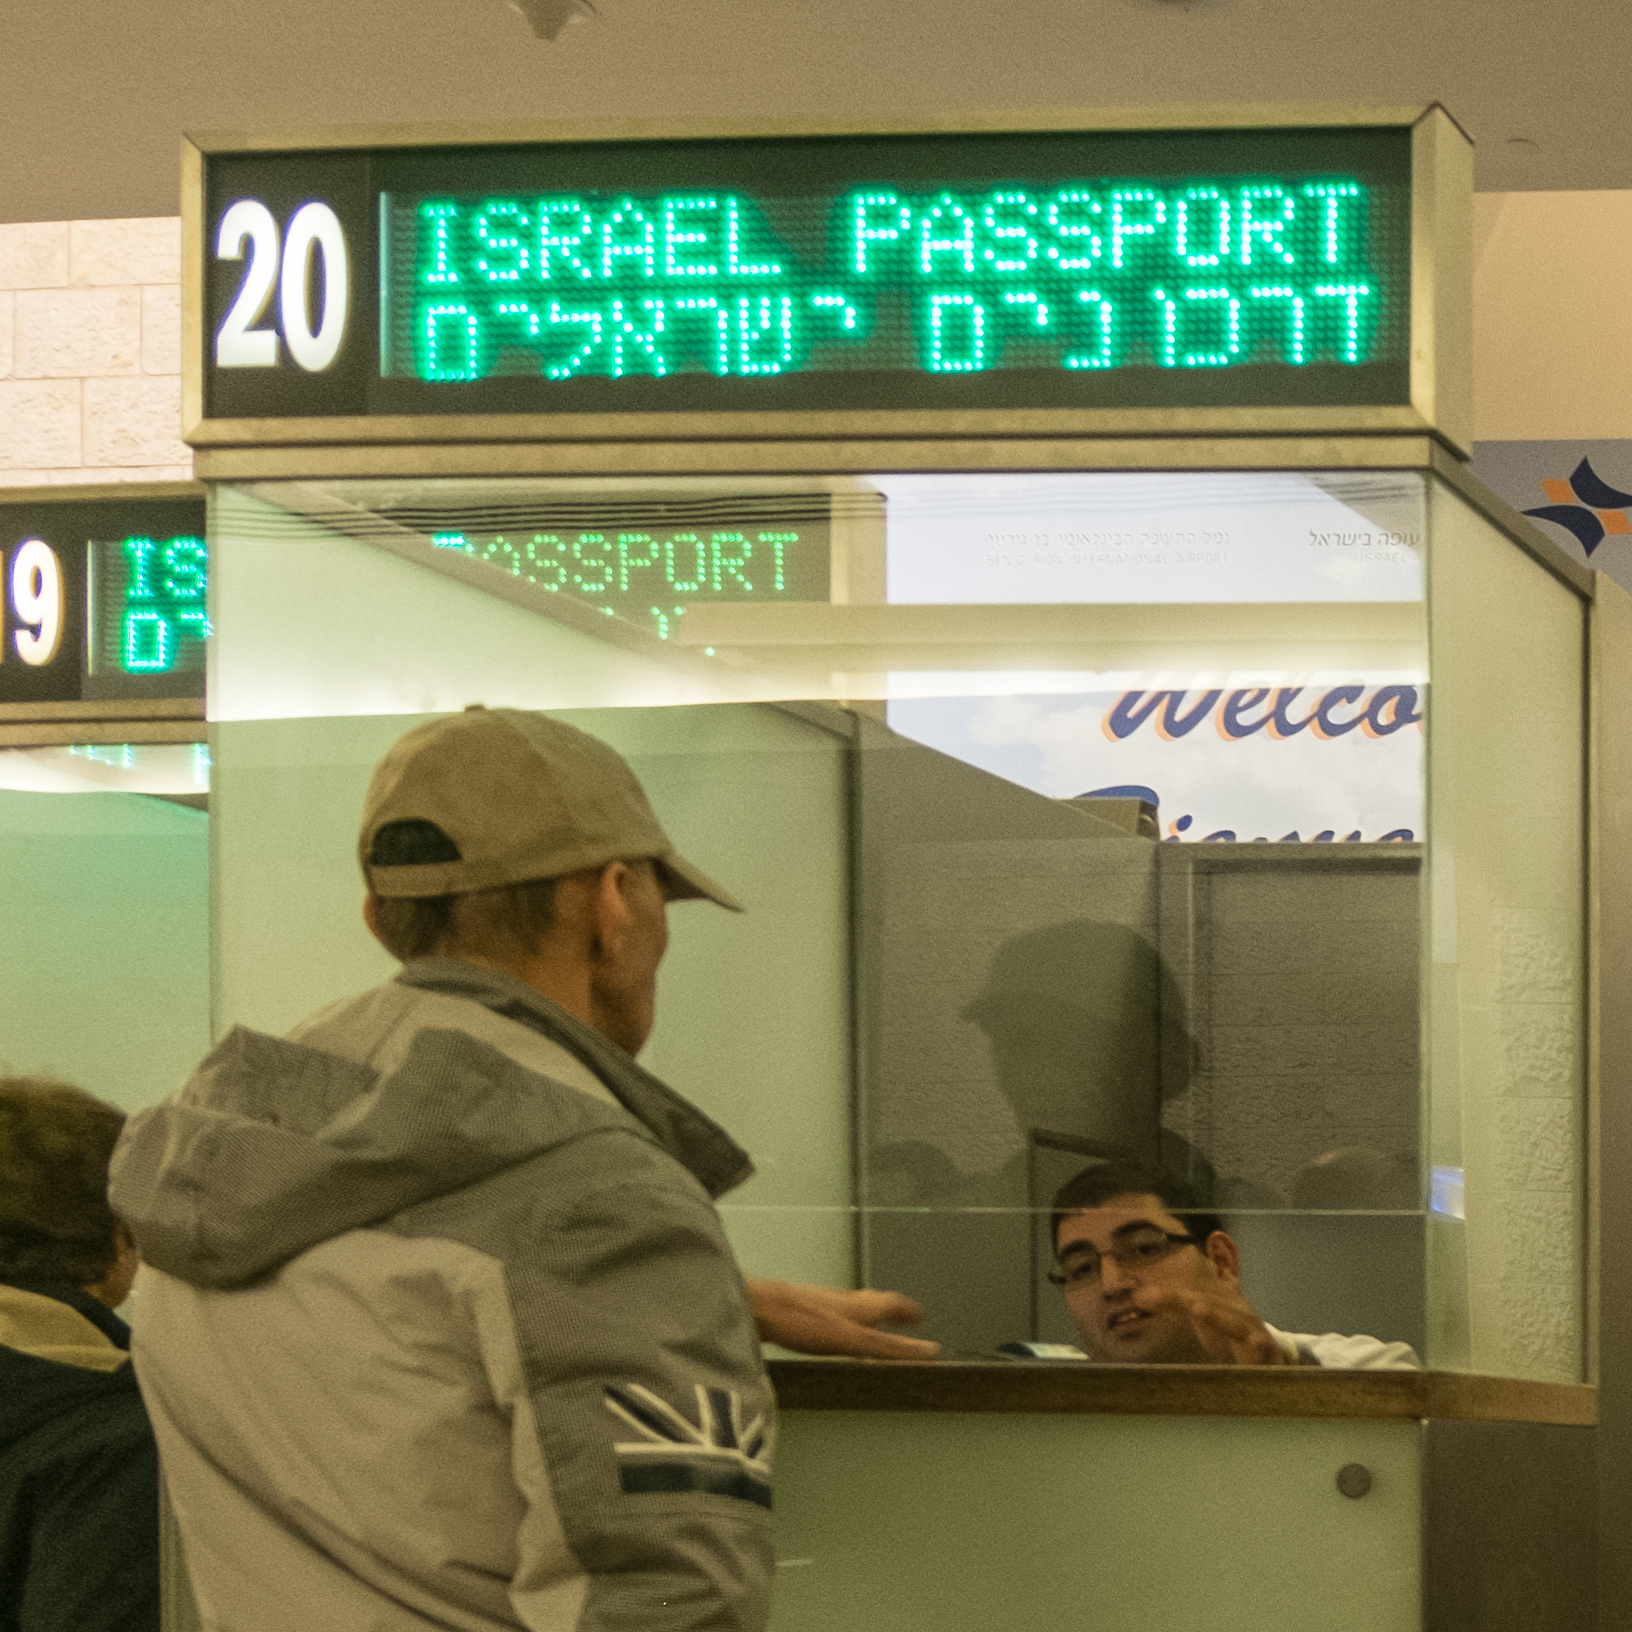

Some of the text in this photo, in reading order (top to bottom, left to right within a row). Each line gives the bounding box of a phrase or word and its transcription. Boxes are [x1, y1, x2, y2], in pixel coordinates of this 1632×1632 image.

[424, 184, 1360, 283] ISRAEL PASSPORT
[215, 199, 349, 372] 20
[427, 284, 1371, 380] דרכונים ישראלים
[1067, 552, 1168, 566] INTERNATIONAL
[1174, 552, 1229, 565] AIRPORT
[1309, 528, 1373, 546] בישראל
[1359, 551, 1408, 563] ISRAEL
[0, 539, 60, 666] 9
[1102, 670, 1422, 742] Welco
